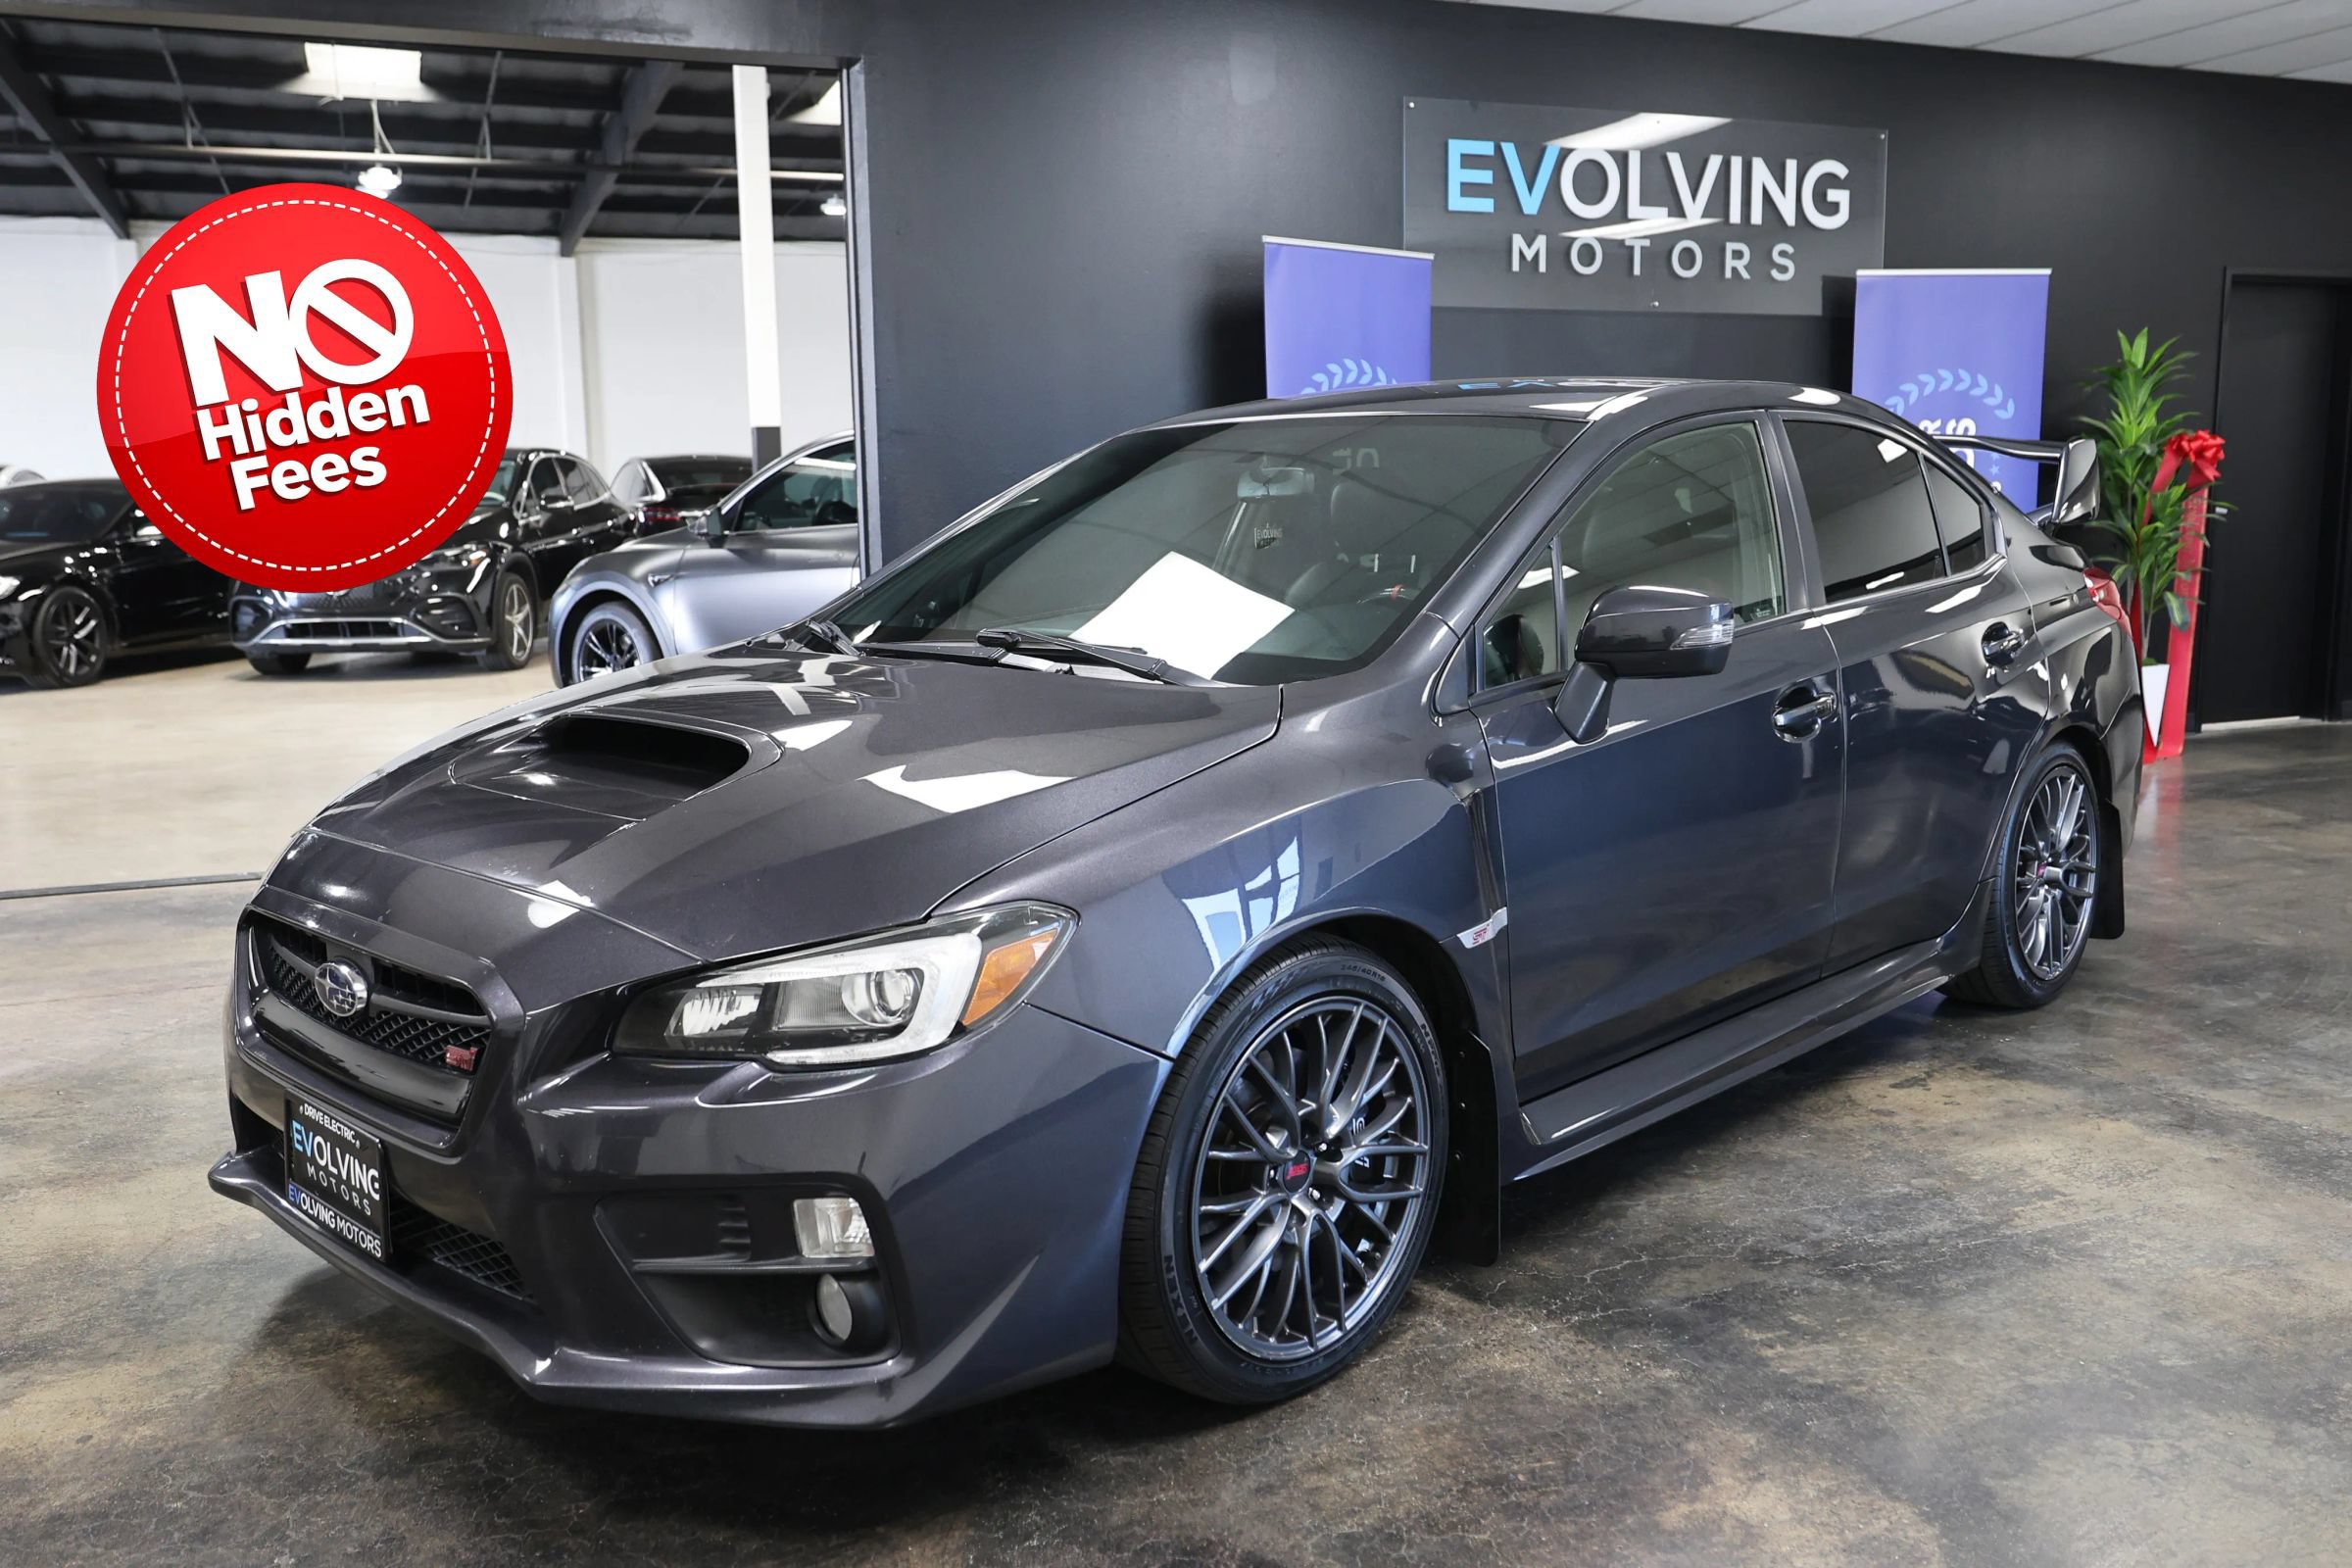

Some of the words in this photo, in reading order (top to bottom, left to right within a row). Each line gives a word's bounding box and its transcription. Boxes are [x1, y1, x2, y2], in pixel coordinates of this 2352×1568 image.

[1446, 138, 1851, 230] EVOLVING
[1510, 233, 1796, 281] MOTORS
[304, 1102, 324, 1126] DRIVE
[323, 1114, 356, 1144] ELECTRIC
[292, 1120, 380, 1201] EVOLVING
[307, 1162, 371, 1216] MOTORS
[288, 1183, 335, 1230] EVOLVING
[336, 1215, 382, 1258] MOTORS
